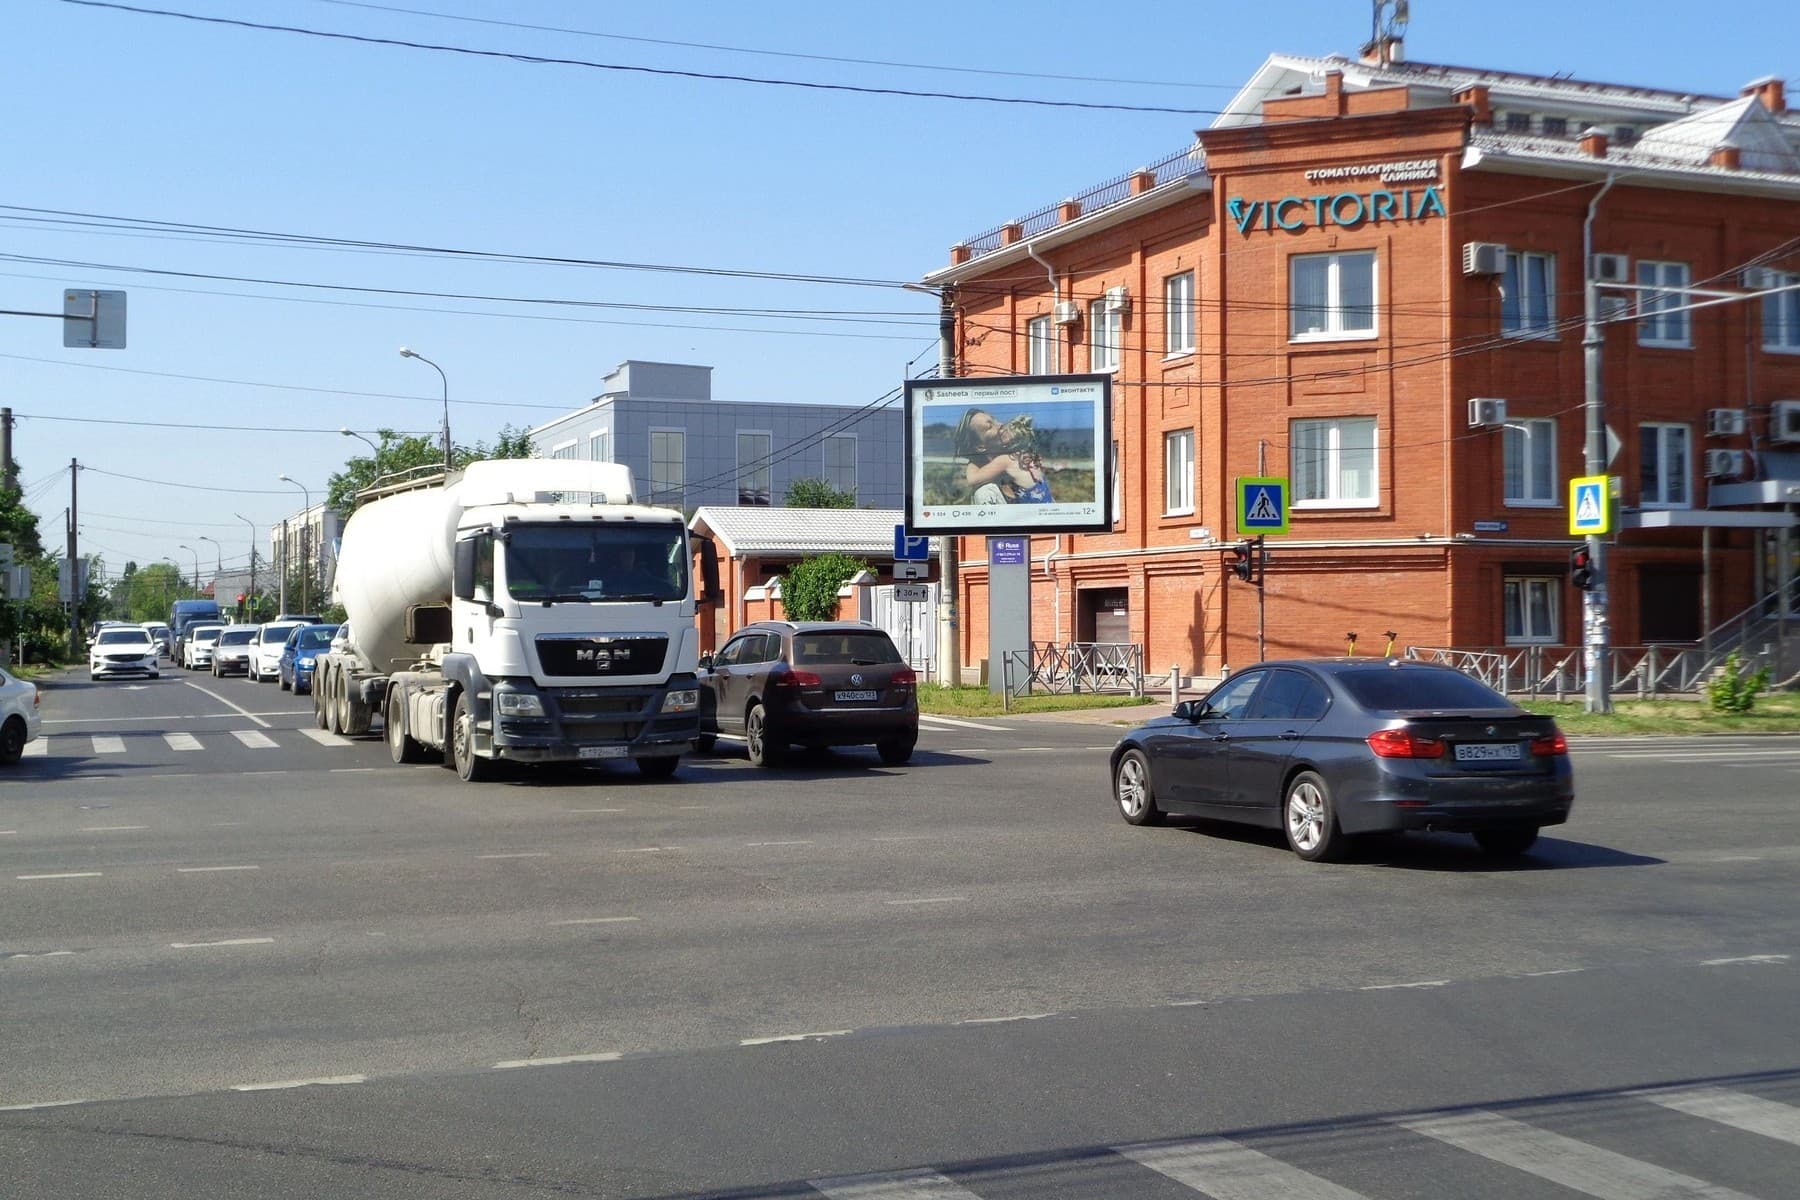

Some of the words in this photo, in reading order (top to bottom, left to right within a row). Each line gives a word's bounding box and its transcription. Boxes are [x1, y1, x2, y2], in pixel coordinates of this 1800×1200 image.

[1304, 160, 1437, 180] СТОМАТОЛОГИЧЕСКАЯ
[1380, 169, 1437, 183] КЛИНИКА
[1227, 186, 1446, 233] VICTORIA
[576, 649, 631, 661] MAN
